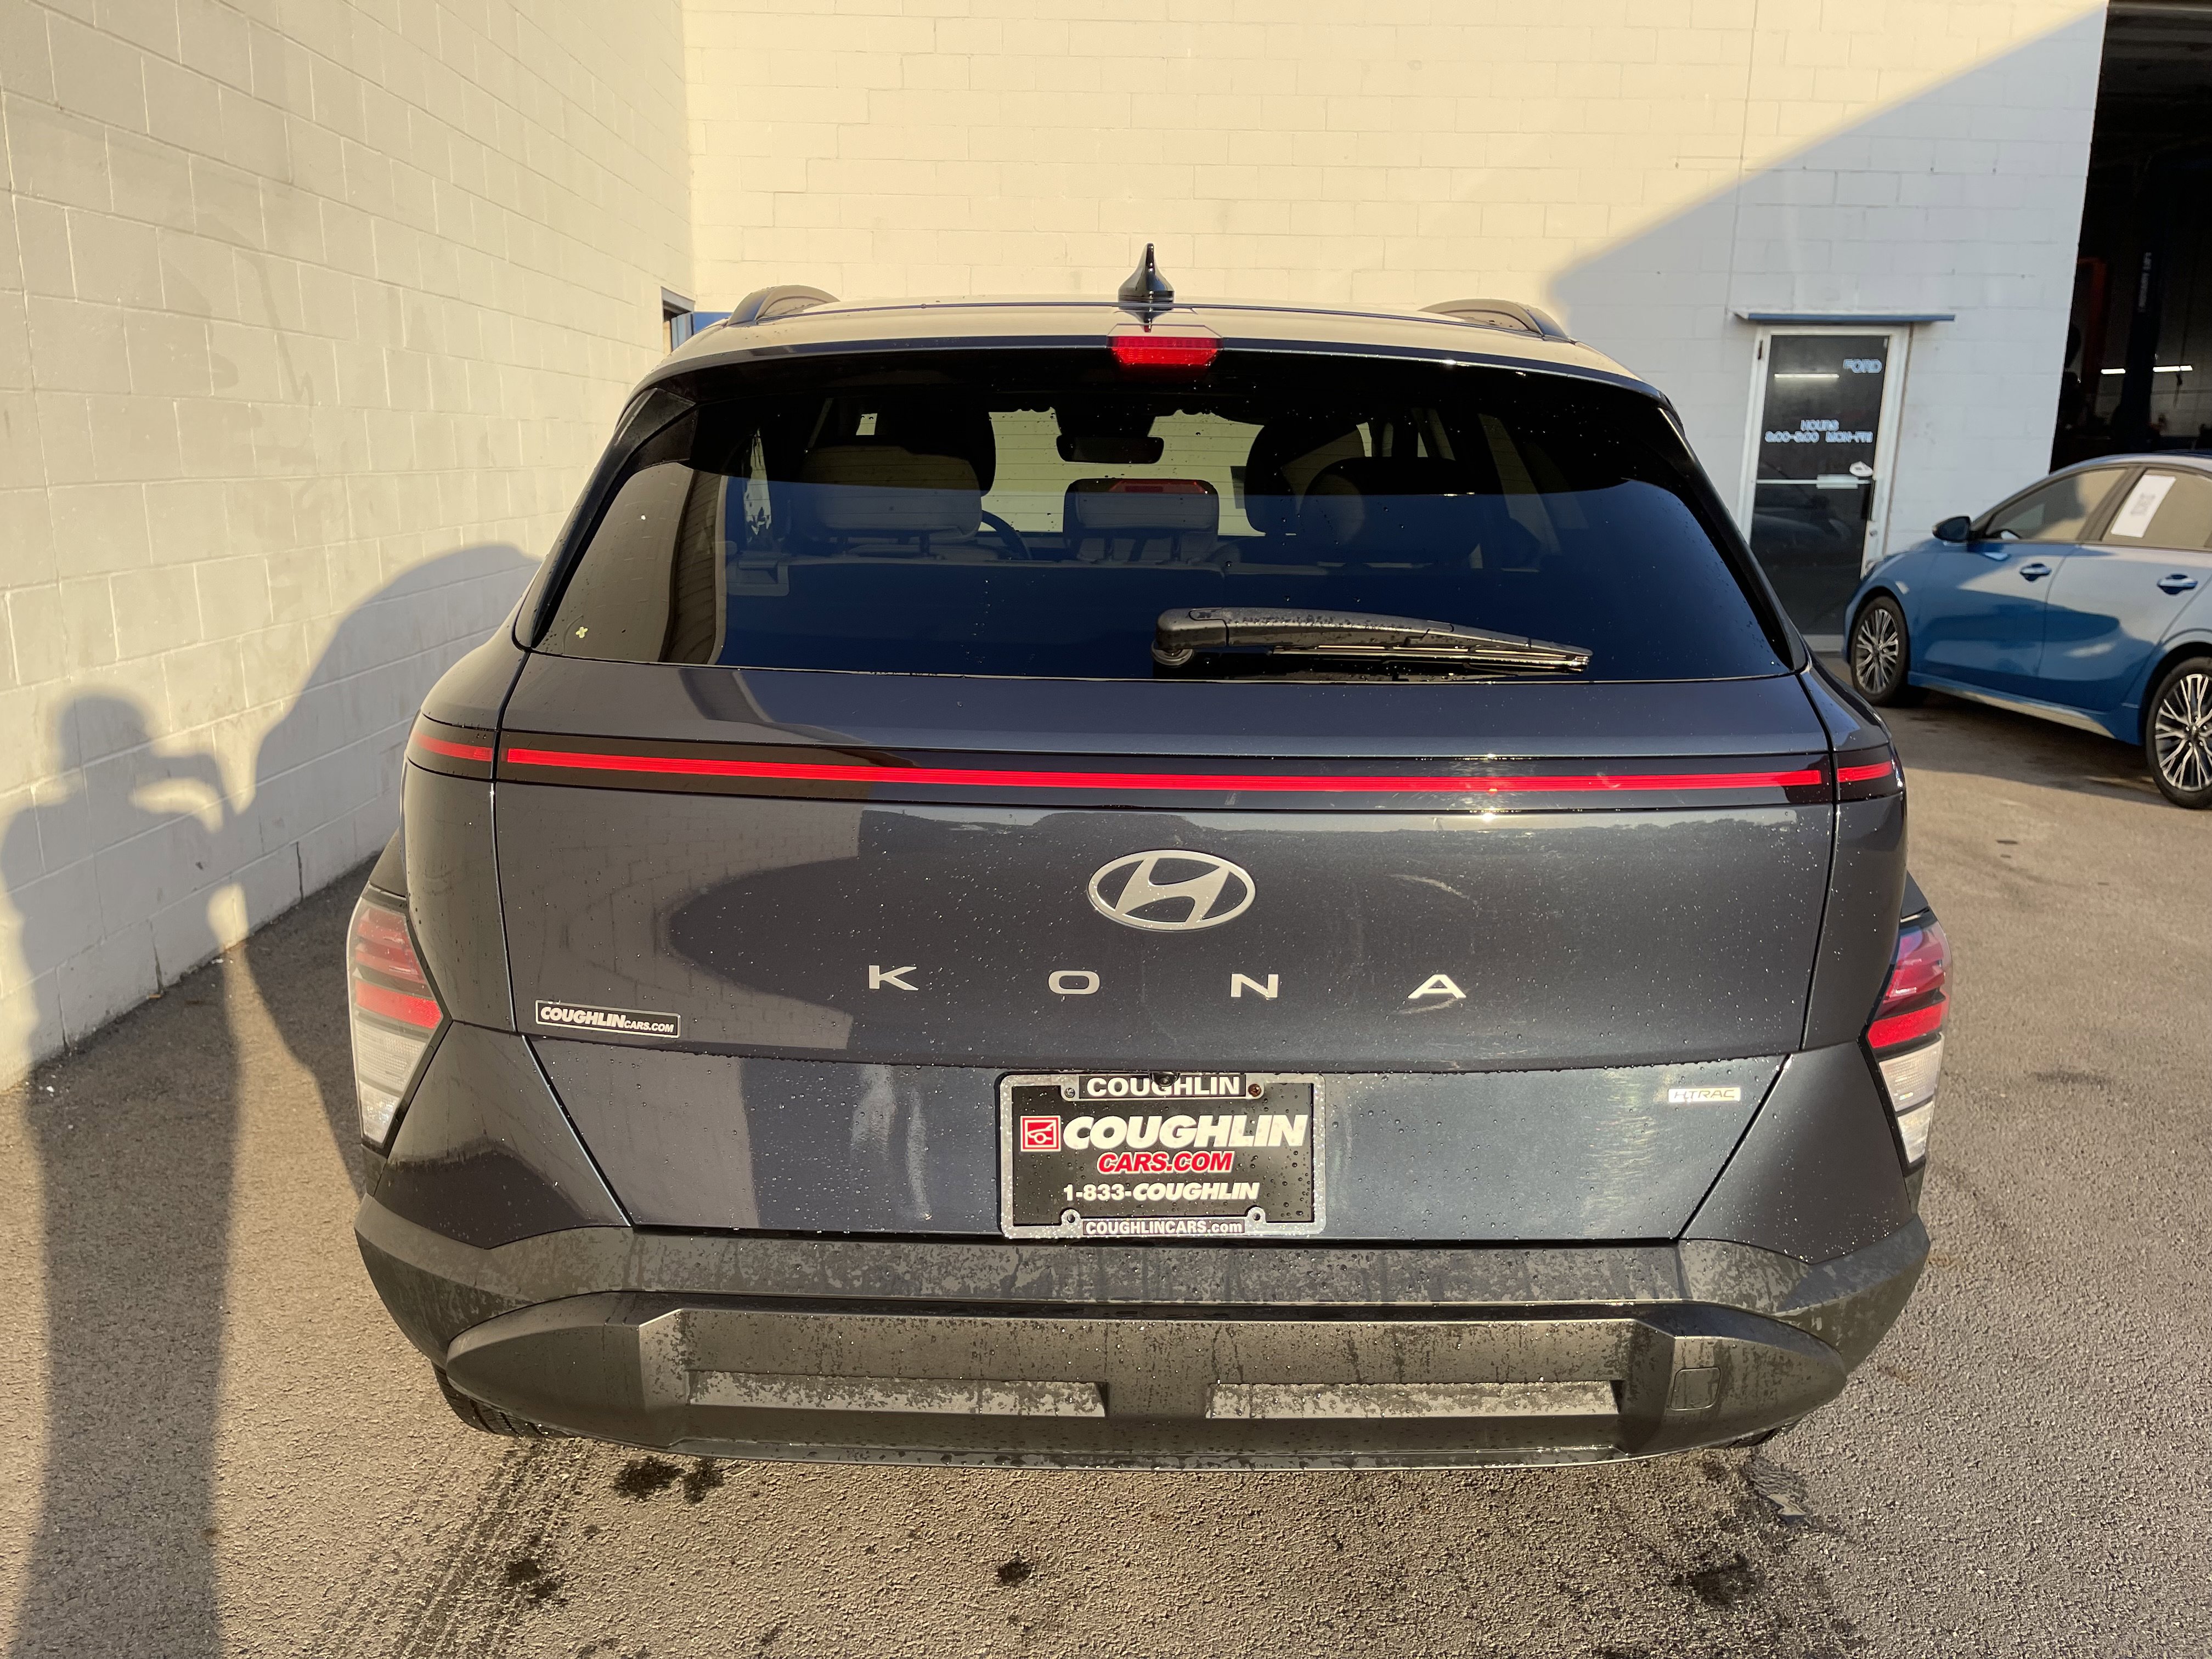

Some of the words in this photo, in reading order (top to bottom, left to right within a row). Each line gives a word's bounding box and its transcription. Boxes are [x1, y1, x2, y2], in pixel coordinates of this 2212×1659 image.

[1801, 420, 1839, 431] HOURS
[868, 964, 1466, 1000] KONA
[1674, 1090, 1734, 1099] HTRAC
[1063, 1114, 1307, 1149] COUGHLIN
[1097, 1151, 1235, 1174] CARS.COM
[1063, 1182, 1260, 1201] 1-833-COUGHLIN
[1086, 1221, 1243, 1235] COUGHLINCARS.com
